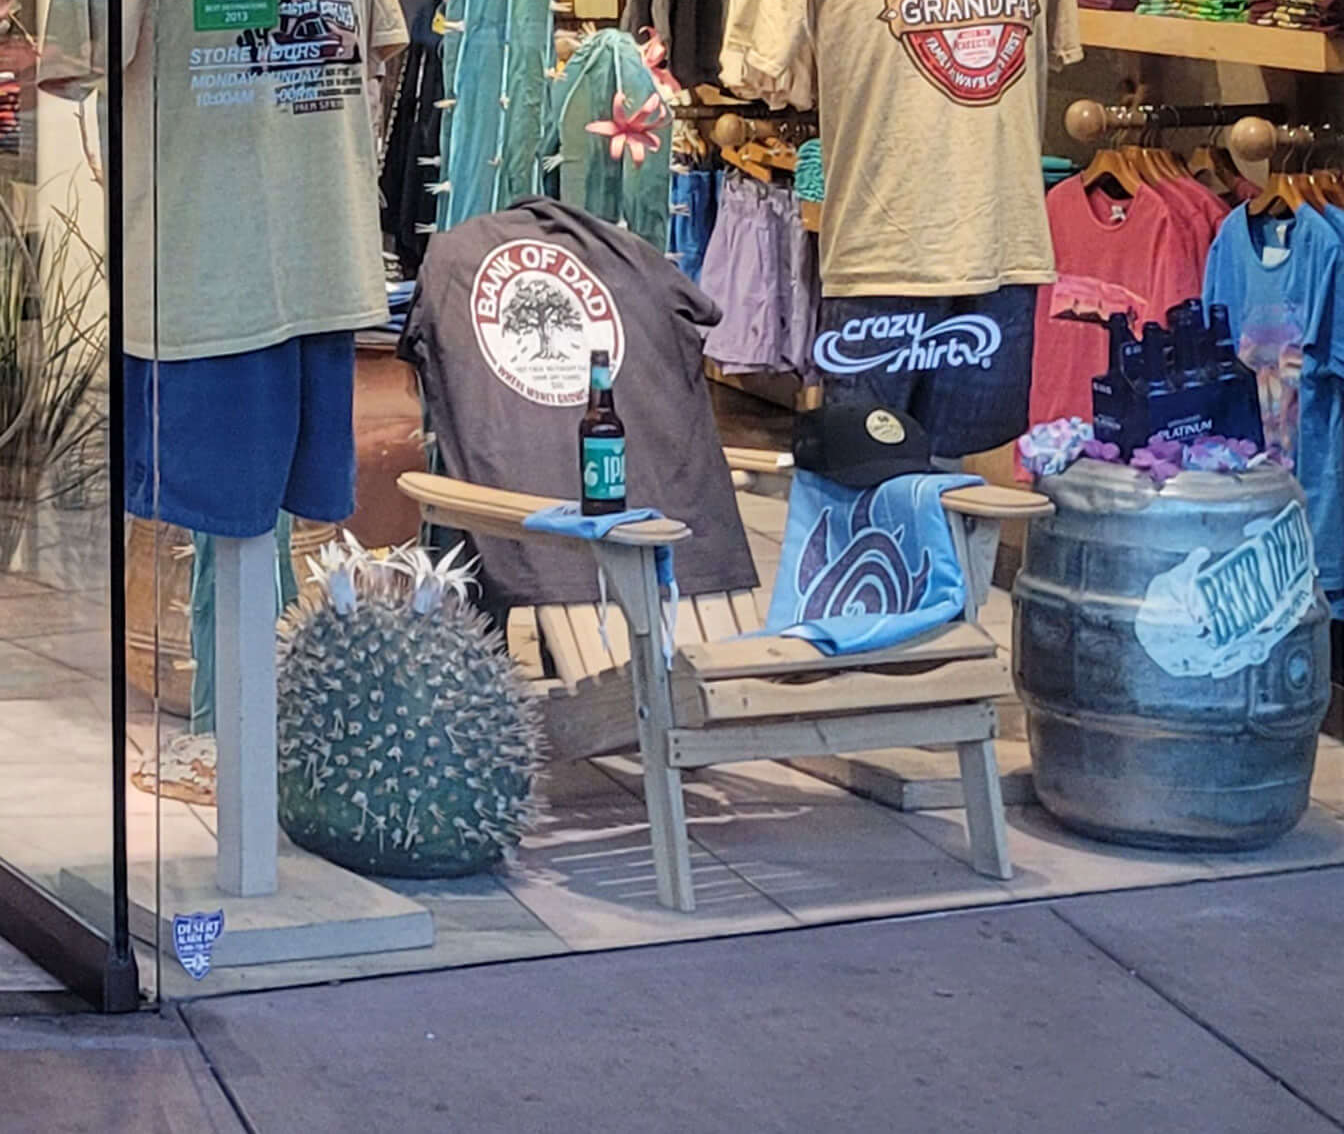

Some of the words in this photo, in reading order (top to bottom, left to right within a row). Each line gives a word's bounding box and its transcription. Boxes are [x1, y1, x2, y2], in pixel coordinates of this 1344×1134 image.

[224, 11, 249, 23] 2013
[189, 45, 253, 65] STORE
[256, 43, 321, 64] HOURS
[477, 251, 521, 318] BANK
[520, 246, 558, 270] OF
[558, 258, 608, 318] DAD
[841, 312, 926, 343] crazy
[886, 337, 981, 374] shirts
[1158, 418, 1213, 440] PLATINUM
[1196, 546, 1274, 647] BEER
